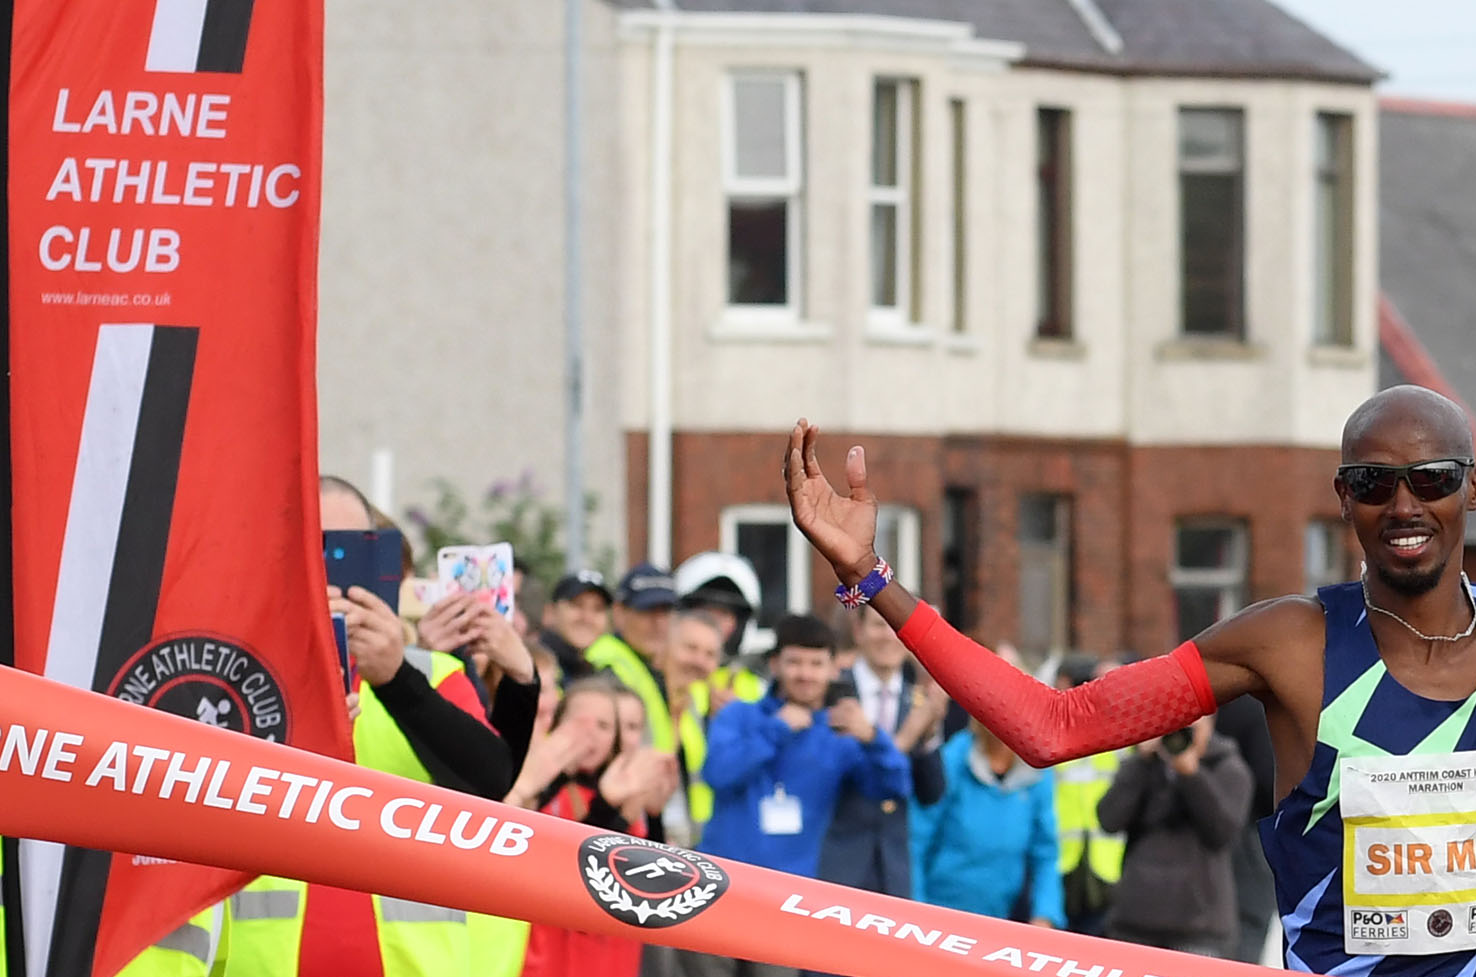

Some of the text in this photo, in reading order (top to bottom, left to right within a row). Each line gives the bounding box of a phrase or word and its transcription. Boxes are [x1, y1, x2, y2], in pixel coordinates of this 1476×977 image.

[52, 87, 231, 138] LARNE
[45, 157, 302, 208] ATHLETIC
[38, 225, 181, 273] CLUB
[41, 291, 171, 306] www.larneac.co.uk
[151, 642, 249, 682] ATHLETIC
[241, 672, 282, 728] CLUB
[0, 724, 535, 857] NE ATHLETIC CLUB
[1370, 773, 1396, 783] 2020
[1400, 770, 1439, 781] ANTRIM
[1442, 768, 1471, 779] COAST
[1408, 782, 1463, 794] MARATHON
[1366, 843, 1433, 876] SIR
[780, 894, 977, 954] LARNE
[1353, 912, 1383, 925] P&O
[1353, 927, 1406, 937] FERRIES
